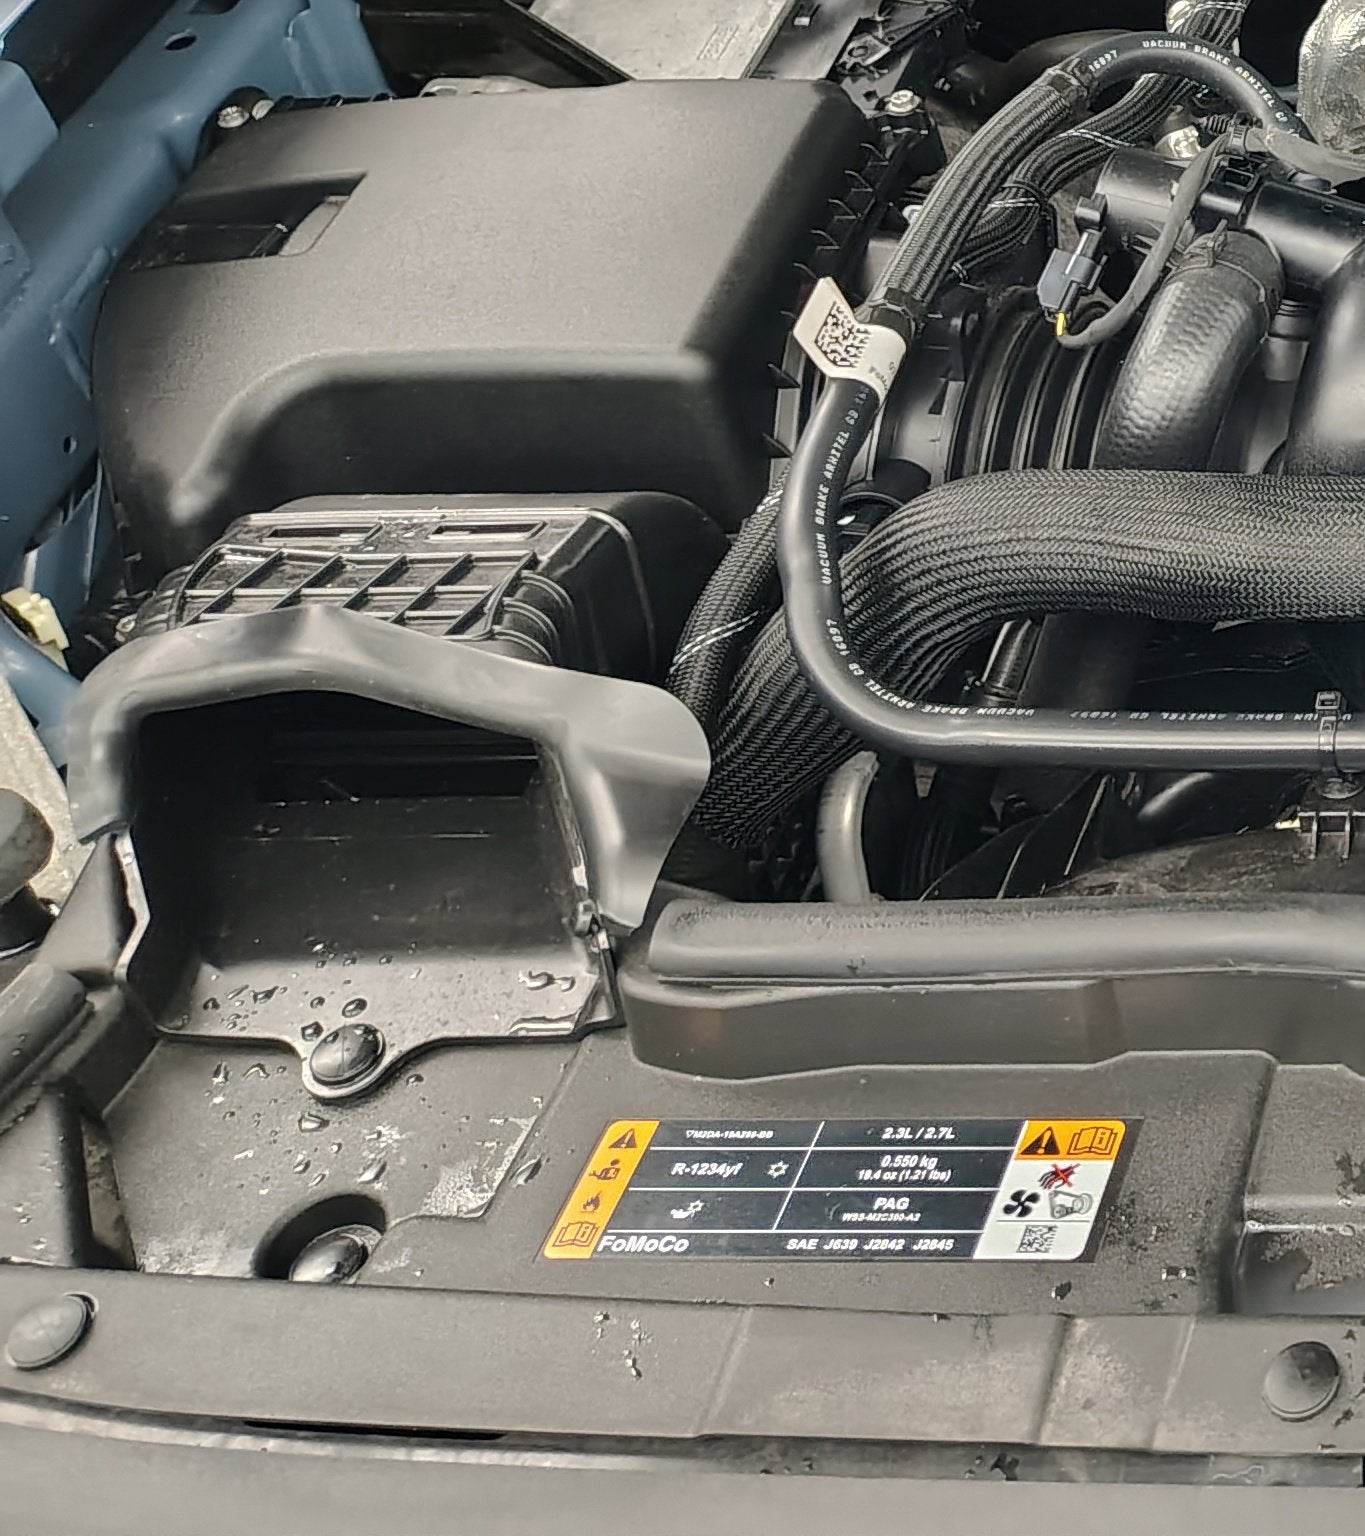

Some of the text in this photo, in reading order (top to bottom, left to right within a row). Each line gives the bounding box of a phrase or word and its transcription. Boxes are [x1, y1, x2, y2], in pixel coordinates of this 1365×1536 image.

[1142, 39, 1187, 50] VACUUM
[1194, 44, 1231, 66] BRAKE
[815, 483, 831, 526] BRAKE
[815, 532, 833, 585] VACUUM
[921, 706, 967, 715] BRAKE
[975, 707, 1035, 717] VACUUM
[882, 1127, 914, 1139] 2.3L
[924, 1127, 955, 1139] 2.7L
[919, 1155, 938, 1170] kg
[671, 1162, 743, 1178] R-1234yf
[883, 1171, 898, 1181] oz
[899, 1169, 927, 1182] (1.21
[928, 1169, 952, 1182] lbs)
[873, 1197, 910, 1210] PAG
[597, 1235, 690, 1252] FoMoCo
[787, 1238, 955, 1250] SAE J639 J2842 J2845
